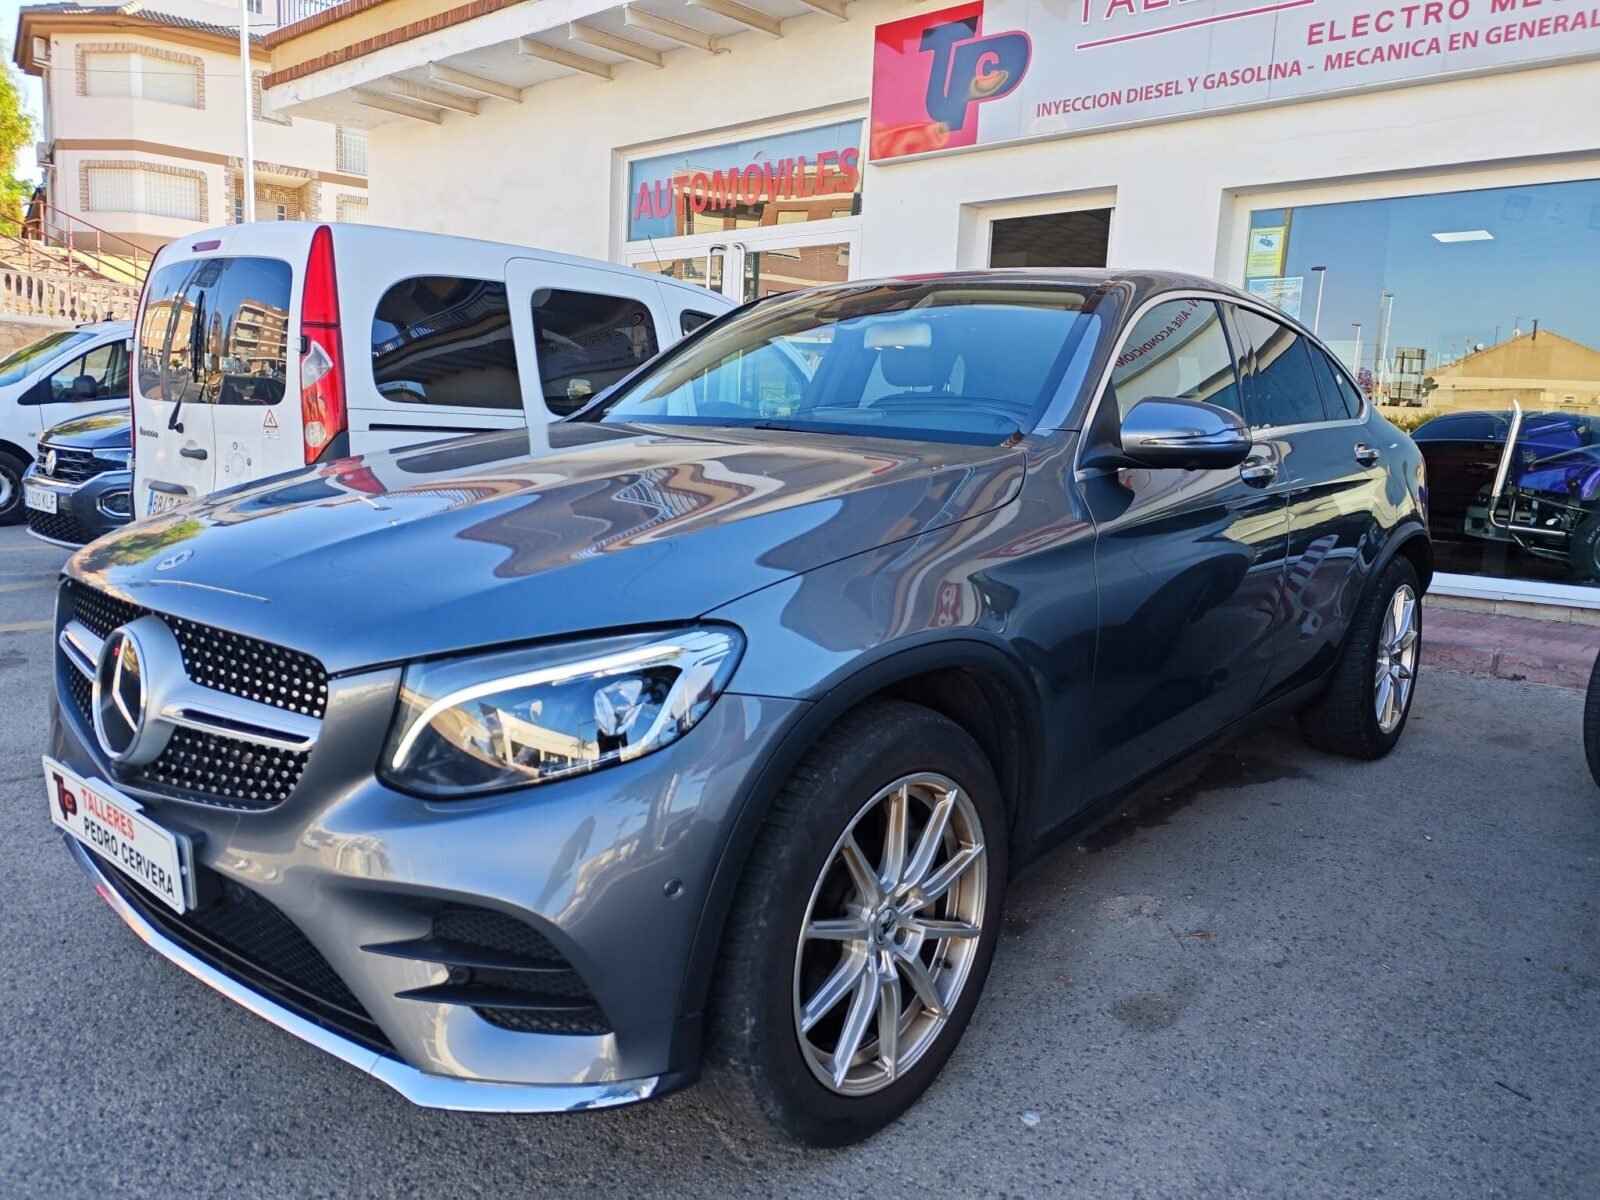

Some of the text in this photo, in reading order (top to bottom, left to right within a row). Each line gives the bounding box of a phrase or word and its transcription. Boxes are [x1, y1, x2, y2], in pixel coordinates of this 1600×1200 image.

[1307, 0, 1470, 46] ELECTRO
[1036, 90, 1122, 118] INYECCION
[1126, 79, 1184, 104] DIESEL
[1187, 75, 1200, 93] Y
[1202, 60, 1302, 90] GASOLINA
[1323, 37, 1441, 72] MECANICA
[1447, 29, 1479, 51] EN
[1484, 8, 1600, 45] GENERAL
[633, 147, 860, 221] AUTOMÓVILES
[81, 788, 135, 841] TALLERES
[84, 816, 175, 898] PEDRO CERVERA
